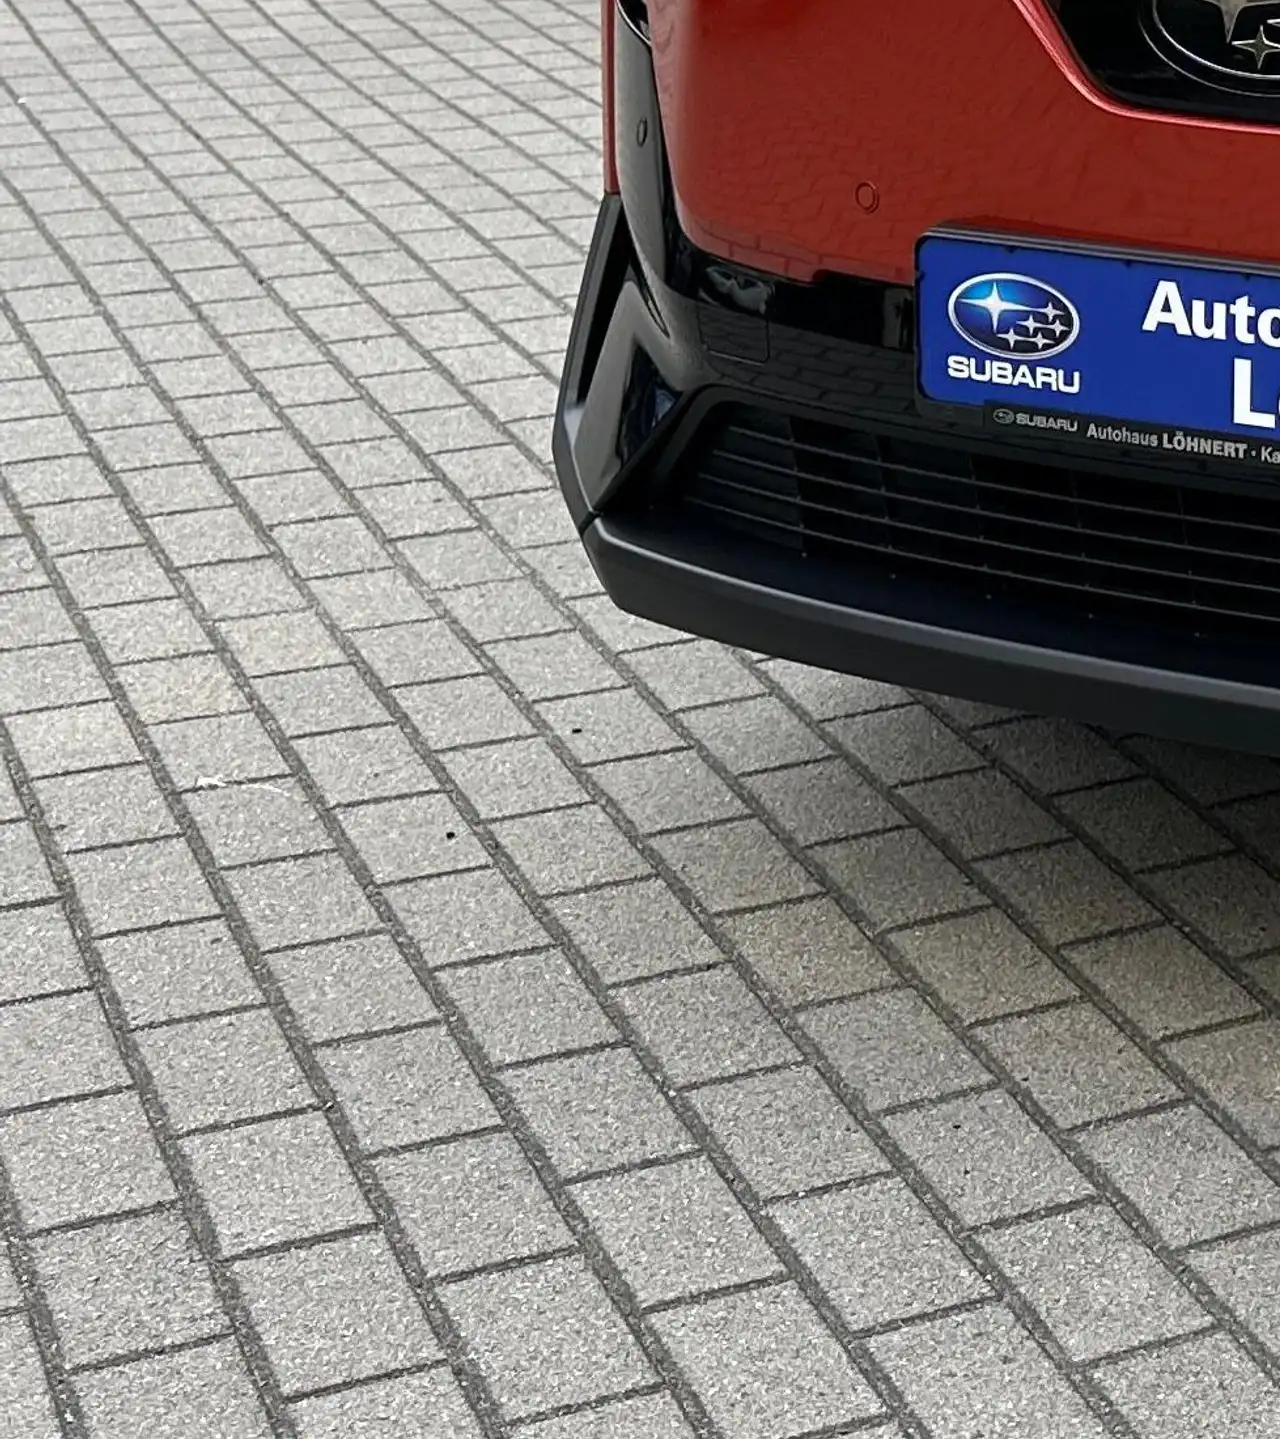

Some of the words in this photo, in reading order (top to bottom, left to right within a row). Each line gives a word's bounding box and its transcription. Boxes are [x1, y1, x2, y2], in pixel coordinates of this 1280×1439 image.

[947, 355, 1081, 394] SUBARU
[1015, 412, 1078, 432] SUBARU
[1086, 423, 1158, 447] Autohaus
[1162, 430, 1248, 459] LÖHNERT
